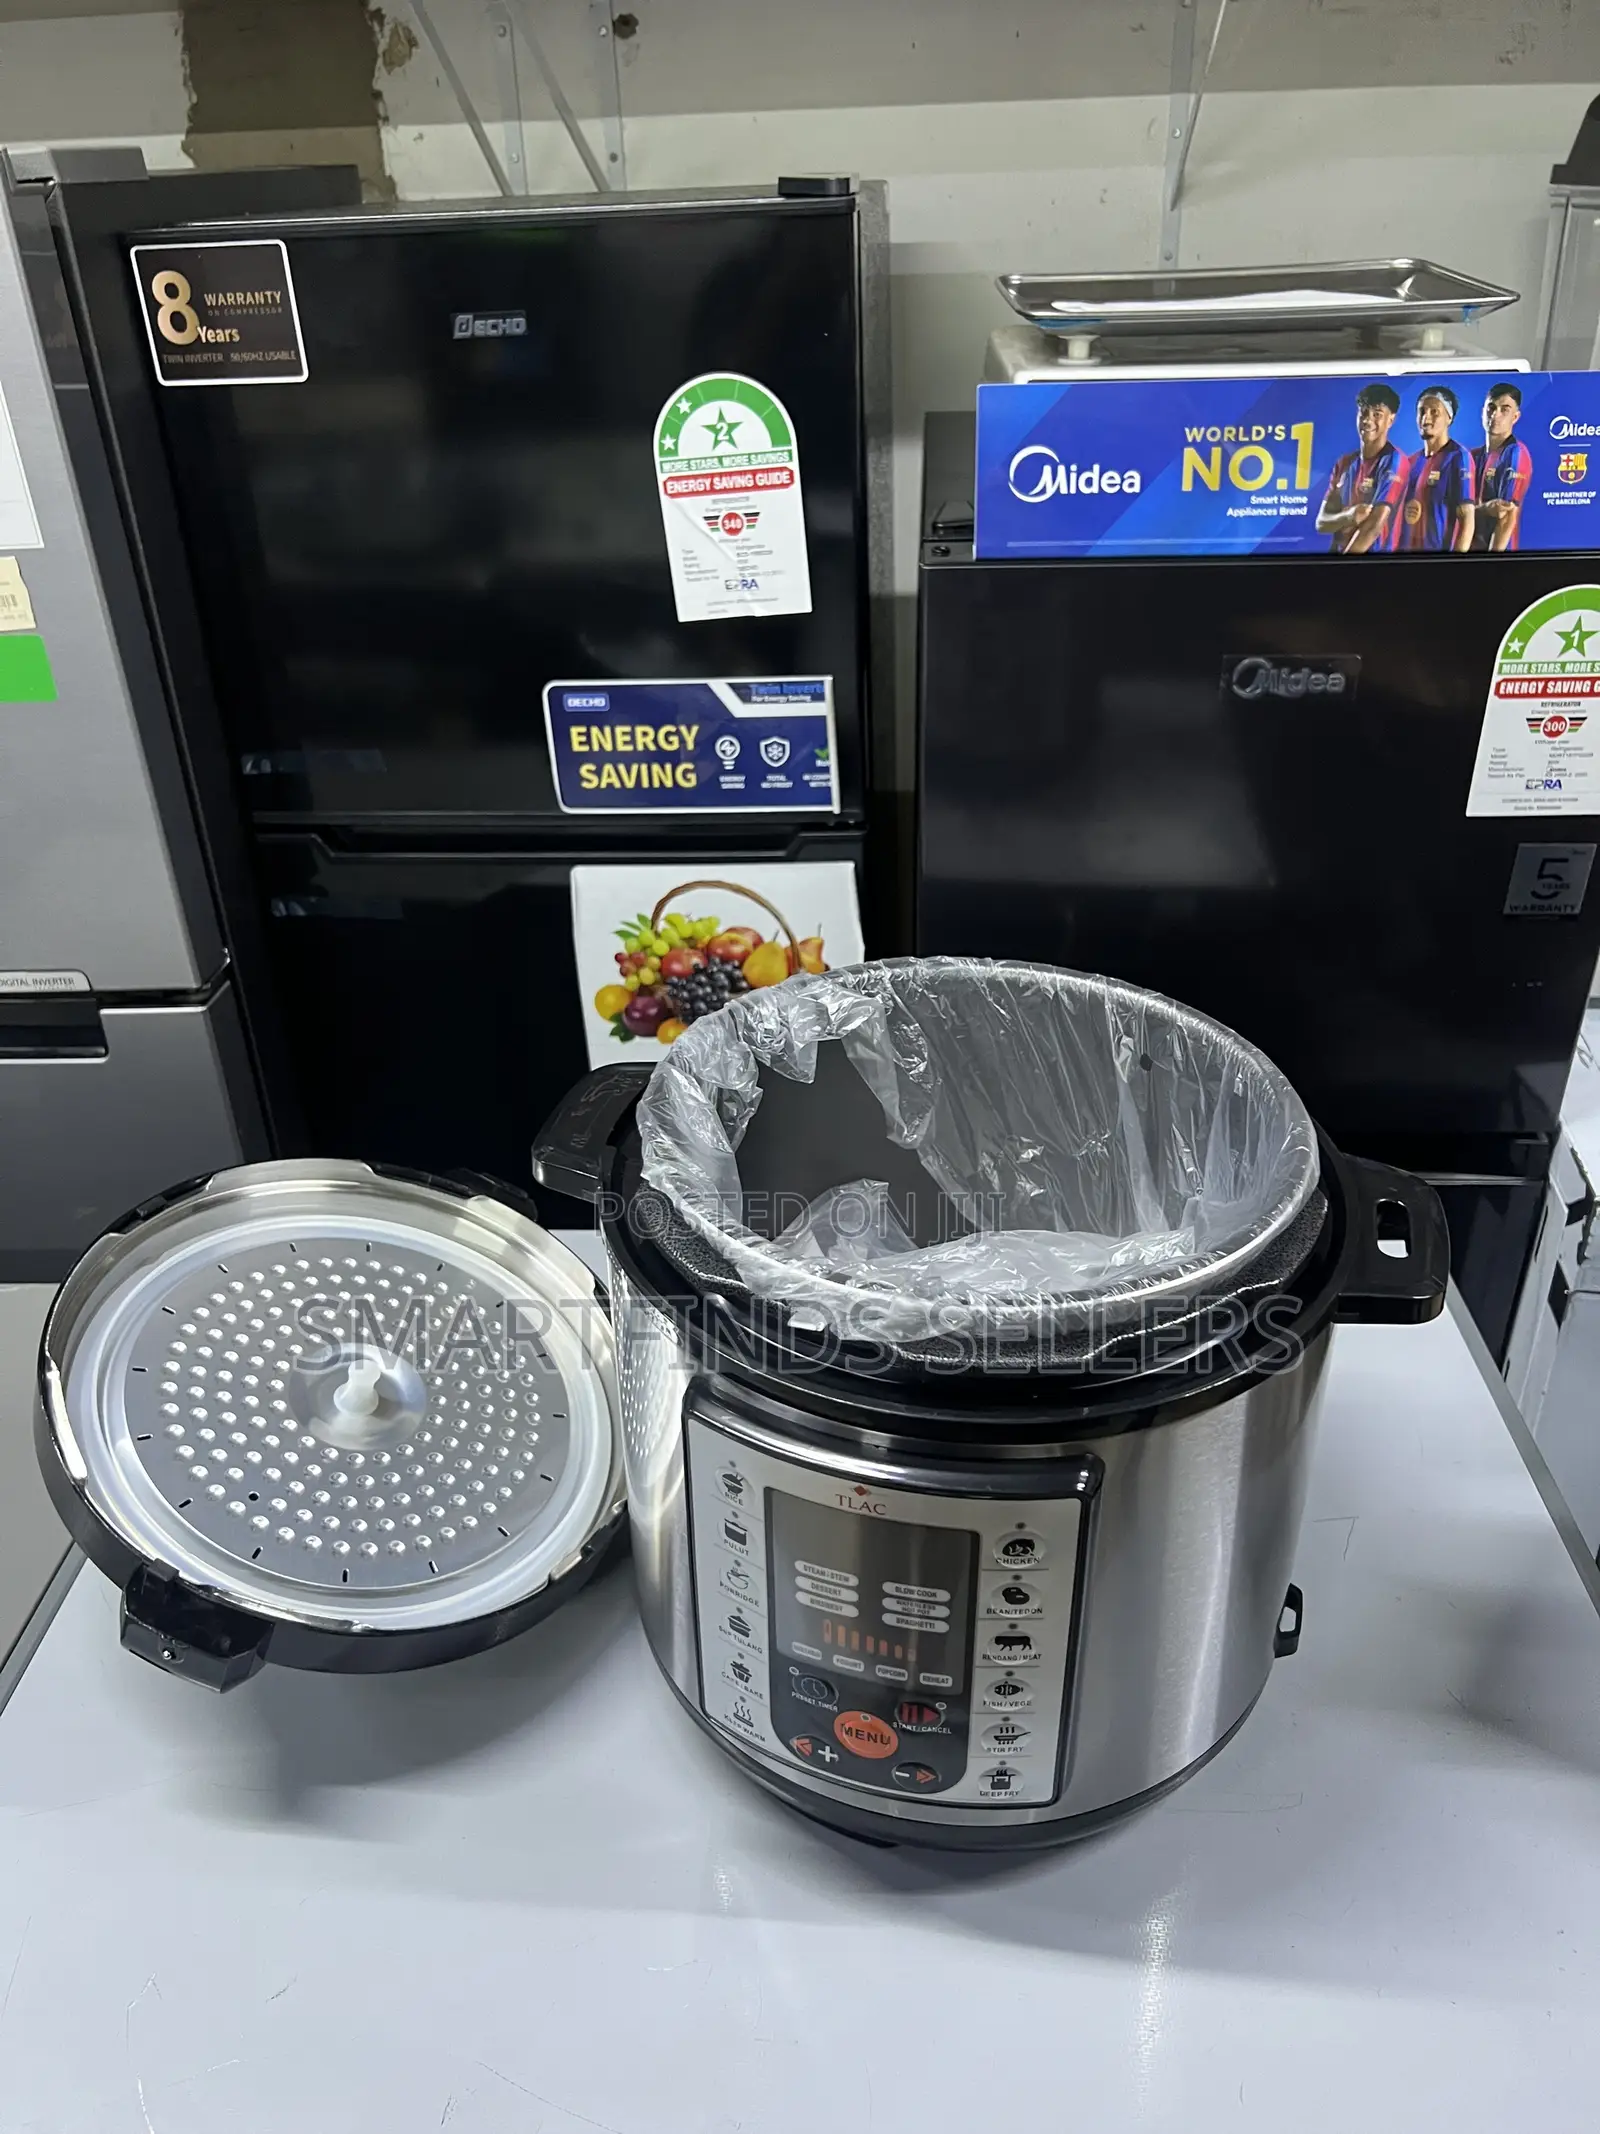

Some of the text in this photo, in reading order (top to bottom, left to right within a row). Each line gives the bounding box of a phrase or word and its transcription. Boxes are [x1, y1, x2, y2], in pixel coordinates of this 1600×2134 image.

[151, 269, 199, 346] 8
[204, 290, 282, 307] WARRANTY
[196, 325, 241, 344] Years
[715, 422, 730, 441] 2
[1184, 425, 1286, 443] WORLD'S
[662, 460, 689, 472] MORE
[722, 455, 749, 467] MORE
[751, 451, 789, 465] SAVINGS
[1181, 422, 1315, 492] NO.1
[666, 471, 791, 494] ENERGY SAVING GUIDE
[1008, 444, 1141, 503] Midea
[1250, 495, 1308, 505] Smart Home
[1226, 506, 1308, 518] Appliances Brand
[1570, 630, 1580, 648] 1
[1501, 663, 1529, 674] MORE
[1564, 662, 1592, 673] MORE
[1233, 657, 1346, 700] Midea
[1500, 681, 1545, 695] ENERGY
[1546, 680, 1591, 694] SAVING
[1544, 721, 1566, 733] 300
[569, 725, 700, 752] ENERGY
[579, 762, 698, 790] SAVING
[1530, 858, 1570, 900] 5
[1508, 903, 1576, 913] WARRANTY
[724, 1492, 744, 1506] RICE
[835, 1494, 887, 1516] TLAC
[724, 1539, 750, 1557] PULUT
[995, 1557, 1040, 1565] CHICKEN
[811, 1582, 842, 1597] DESSERT
[895, 1616, 936, 1630] SPAGHETTI
[877, 1666, 906, 1679] POPCORN
[922, 1675, 950, 1685] REHEAT
[818, 1700, 838, 1712] TIMER
[840, 1723, 891, 1746] MENU
[979, 1790, 1003, 1798] DEEP
